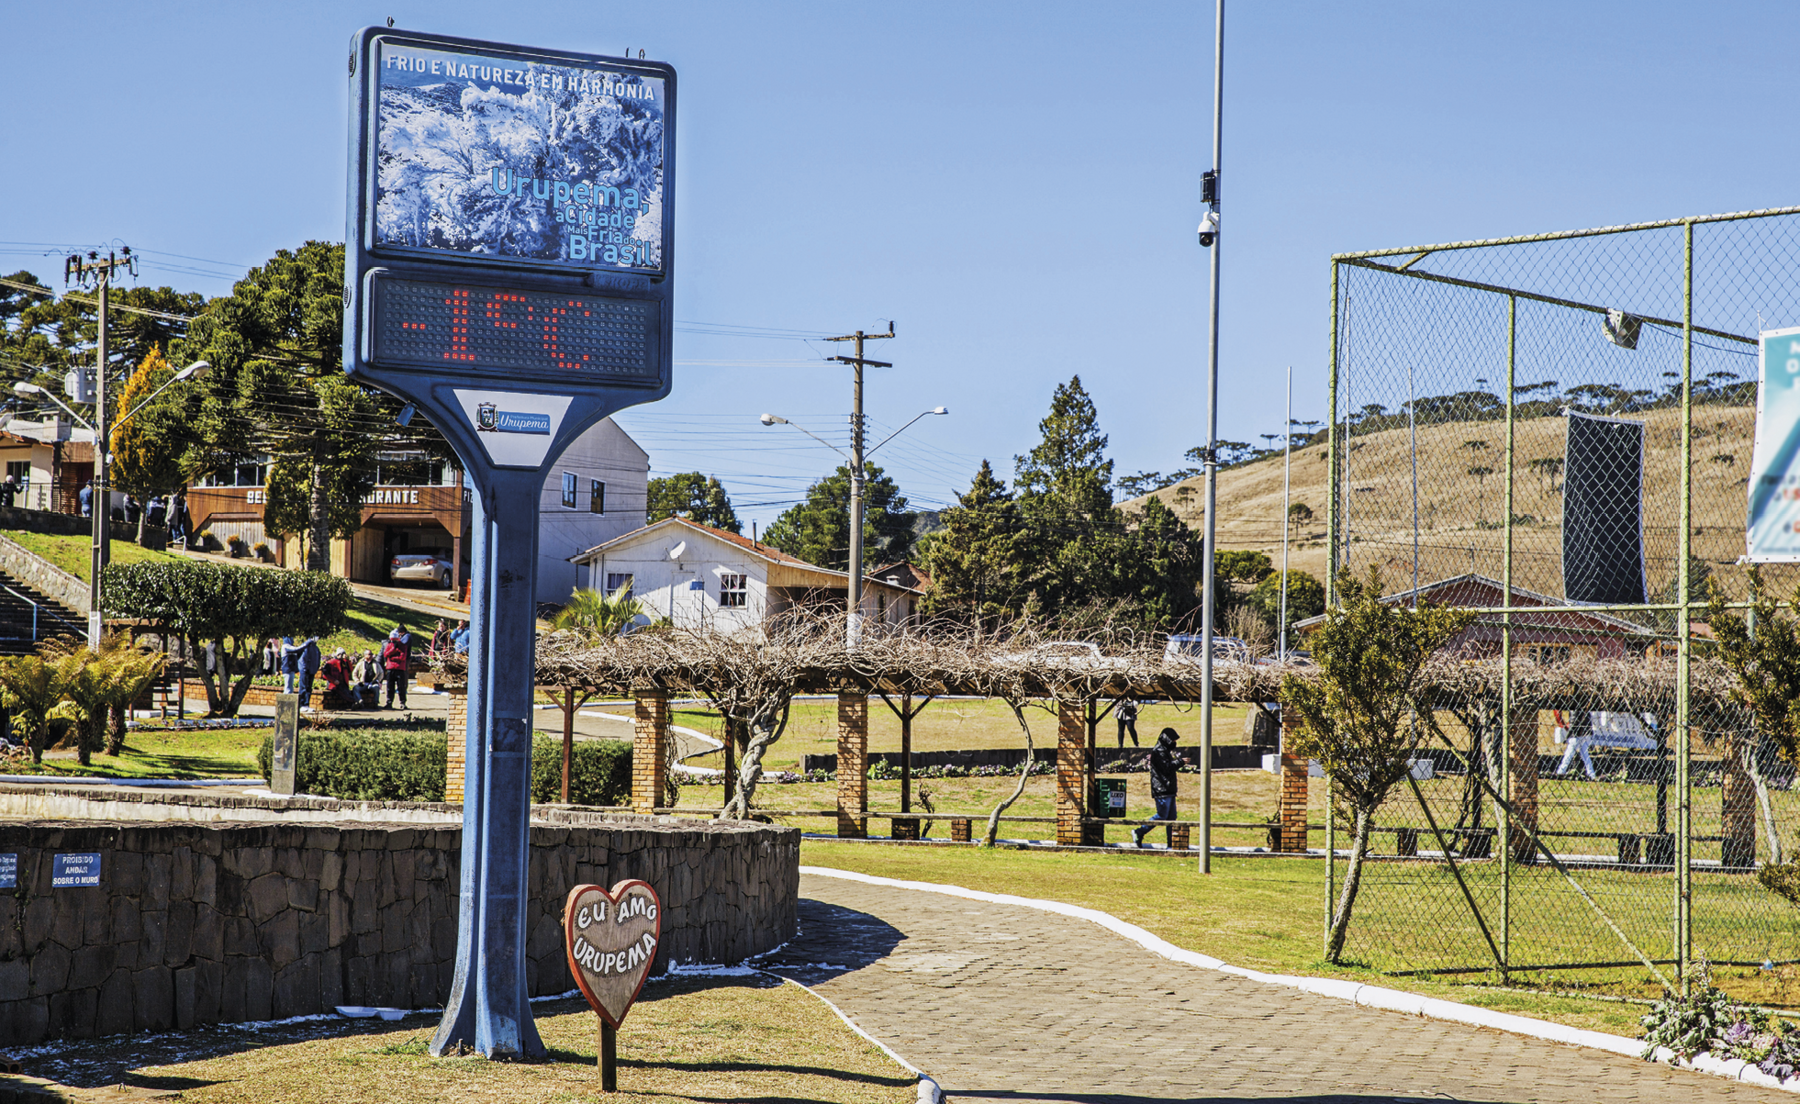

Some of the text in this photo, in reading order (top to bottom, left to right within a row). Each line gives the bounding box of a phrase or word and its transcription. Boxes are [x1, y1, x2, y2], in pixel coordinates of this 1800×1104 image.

[387, 55, 655, 100] FRIO E NATUREZA EM HARMONIA
[491, 166, 649, 217] Urupema,
[565, 204, 635, 230] Cidade
[567, 225, 635, 245] Mais Fria do
[569, 234, 653, 266] Brasil
[500, 414, 549, 430] Urupema
[53, 877, 74, 885] SOBRE
[65, 866, 88, 874] ANDAR
[577, 901, 606, 929] EU
[574, 933, 656, 974] URUPEMA
